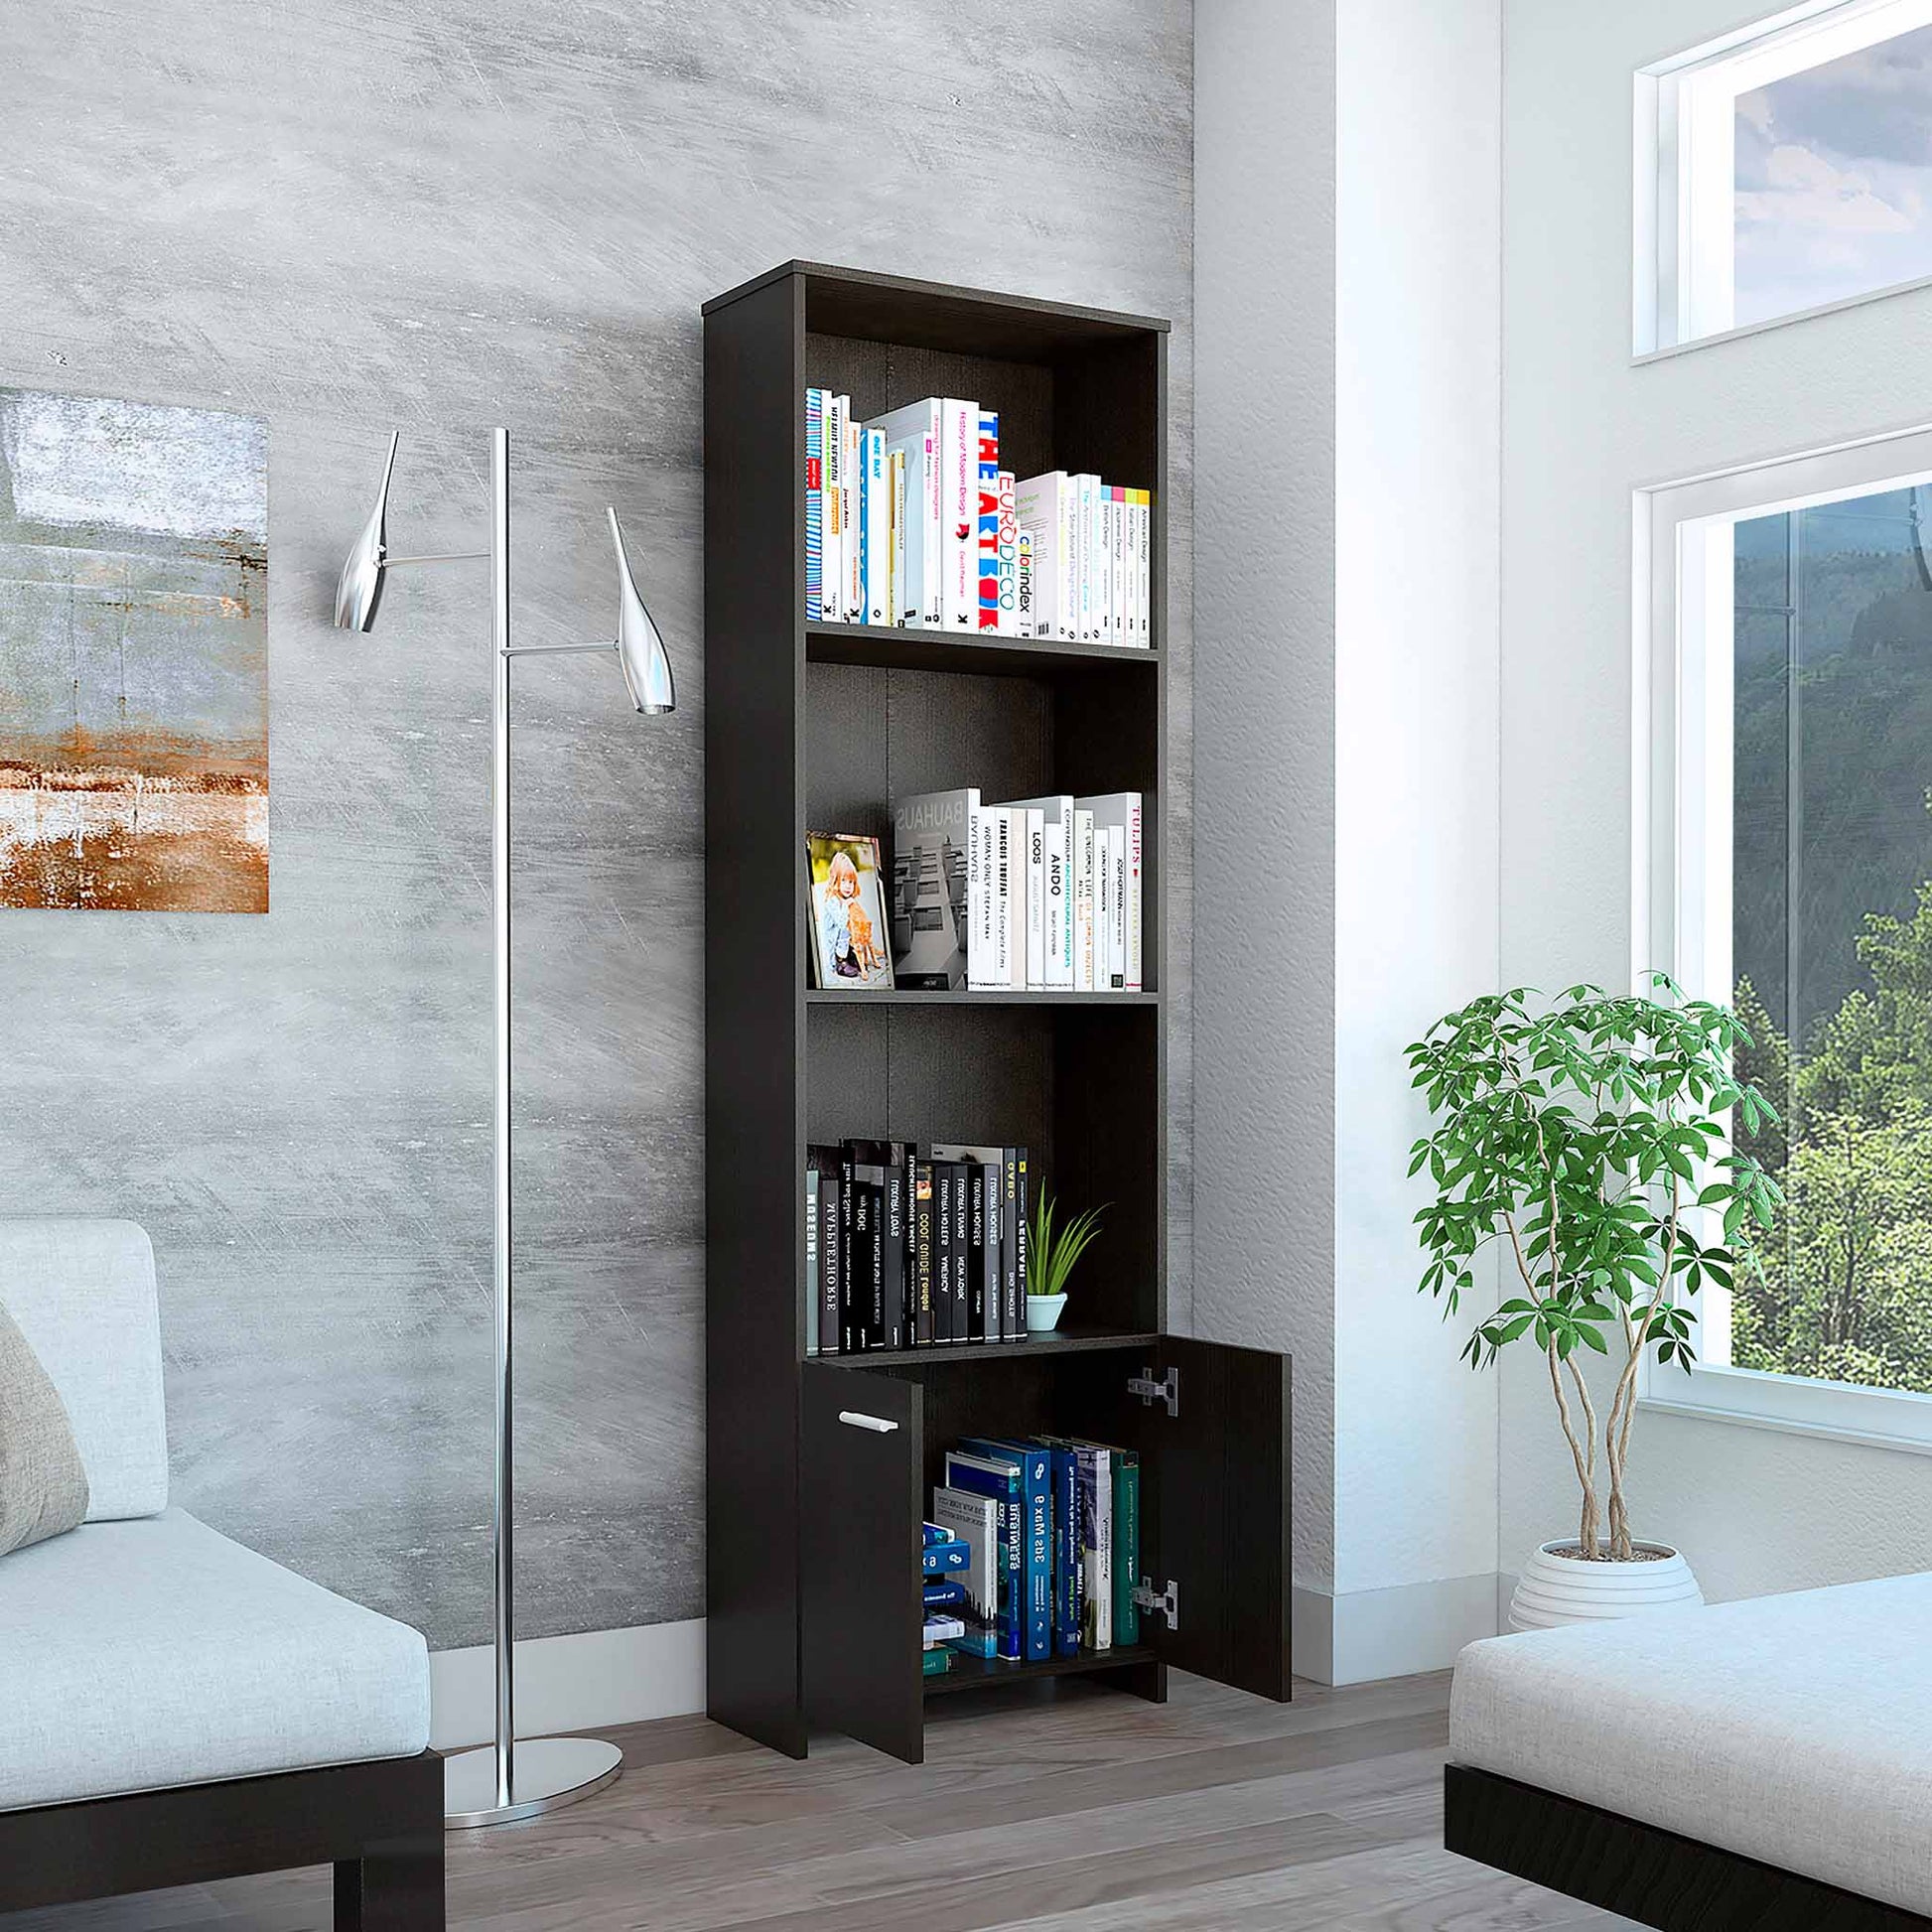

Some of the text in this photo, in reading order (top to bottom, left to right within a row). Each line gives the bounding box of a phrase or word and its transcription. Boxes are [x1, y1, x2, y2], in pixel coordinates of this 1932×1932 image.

[979, 417, 999, 480] THE
[958, 487, 967, 515] Design
[979, 492, 999, 553] ART
[1020, 536, 1033, 613] colorindex
[1033, 832, 1041, 865] LOOS
[1050, 854, 1061, 897] ANDO
